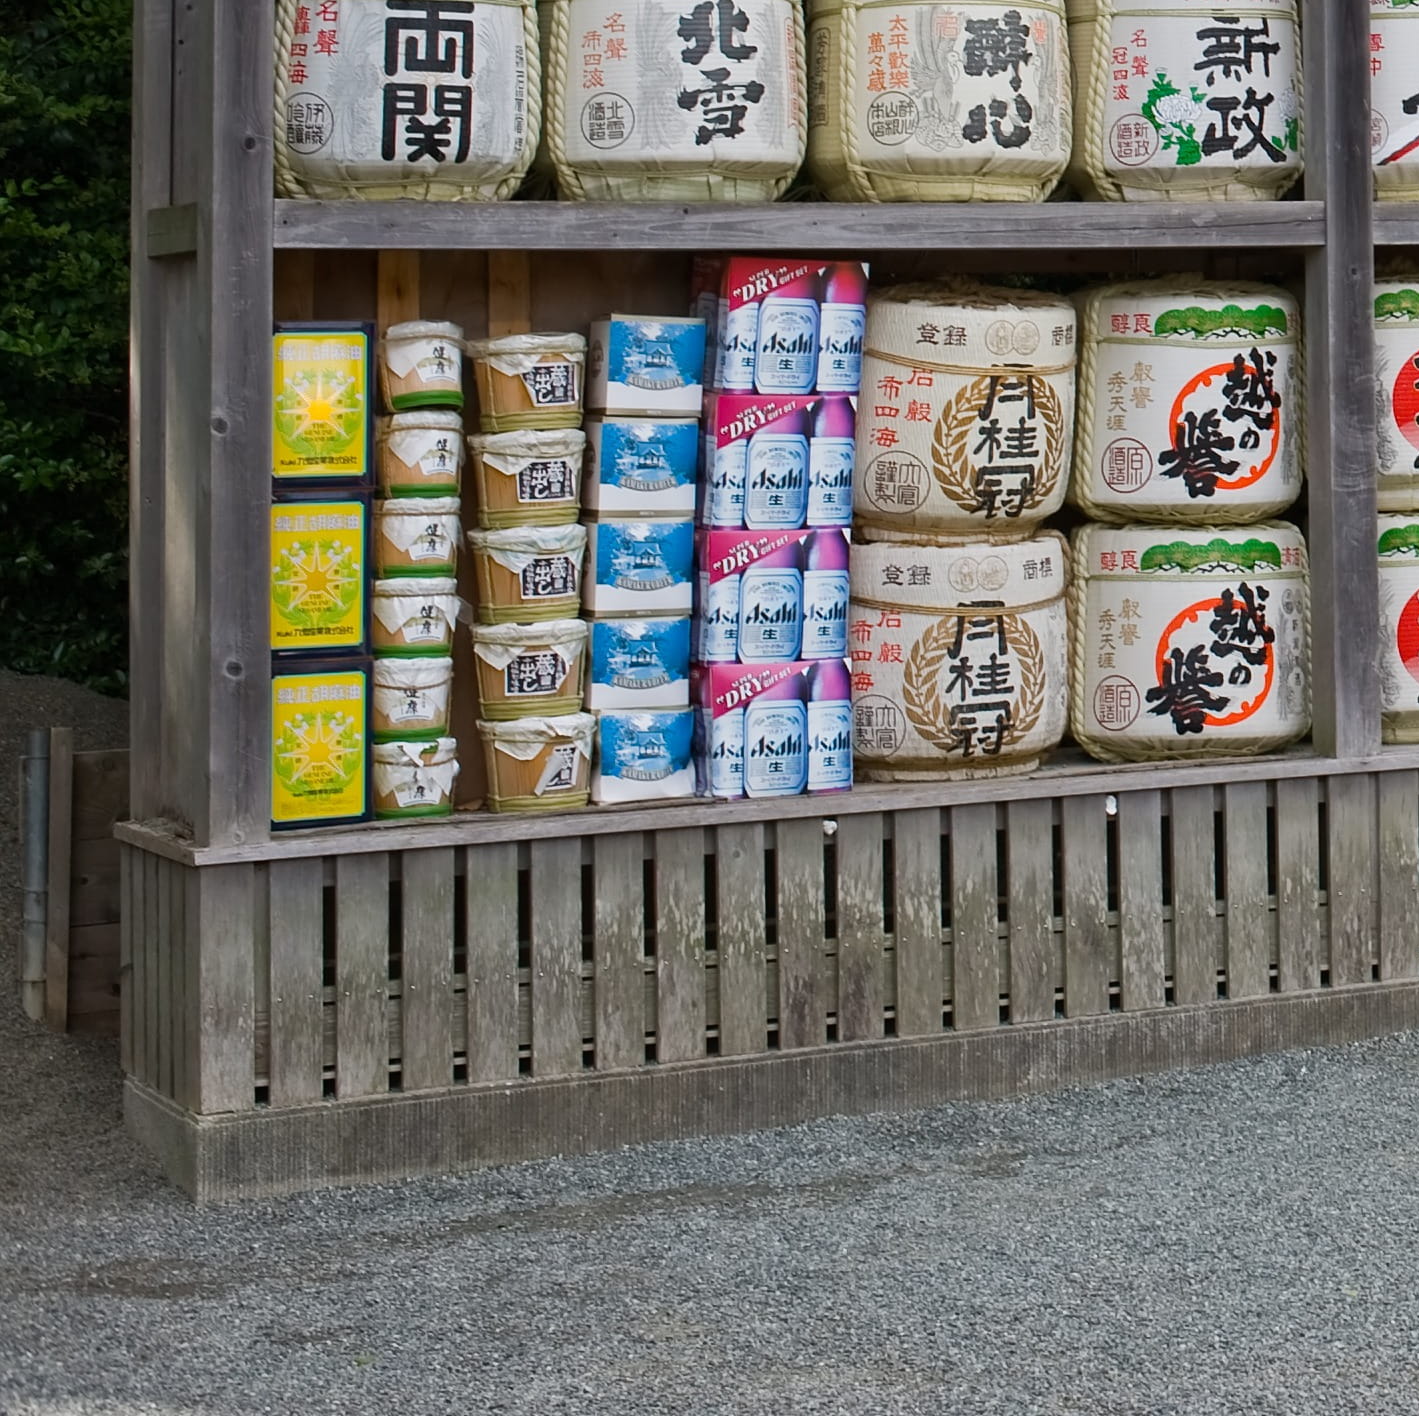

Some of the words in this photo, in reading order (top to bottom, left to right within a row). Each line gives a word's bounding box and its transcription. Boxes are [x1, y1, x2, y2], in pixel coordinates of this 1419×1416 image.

[381, 0, 475, 163] 両関
[1193, 11, 1287, 163] 新政
[741, 274, 779, 302] DRY
[763, 332, 813, 354] Asahi
[729, 410, 767, 439] DRY
[972, 364, 1040, 519] 月桂冠
[752, 468, 803, 490] Asahi
[746, 601, 797, 624] Asahi
[945, 600, 1015, 757] 月桂冠
[751, 734, 801, 758] Asahi
